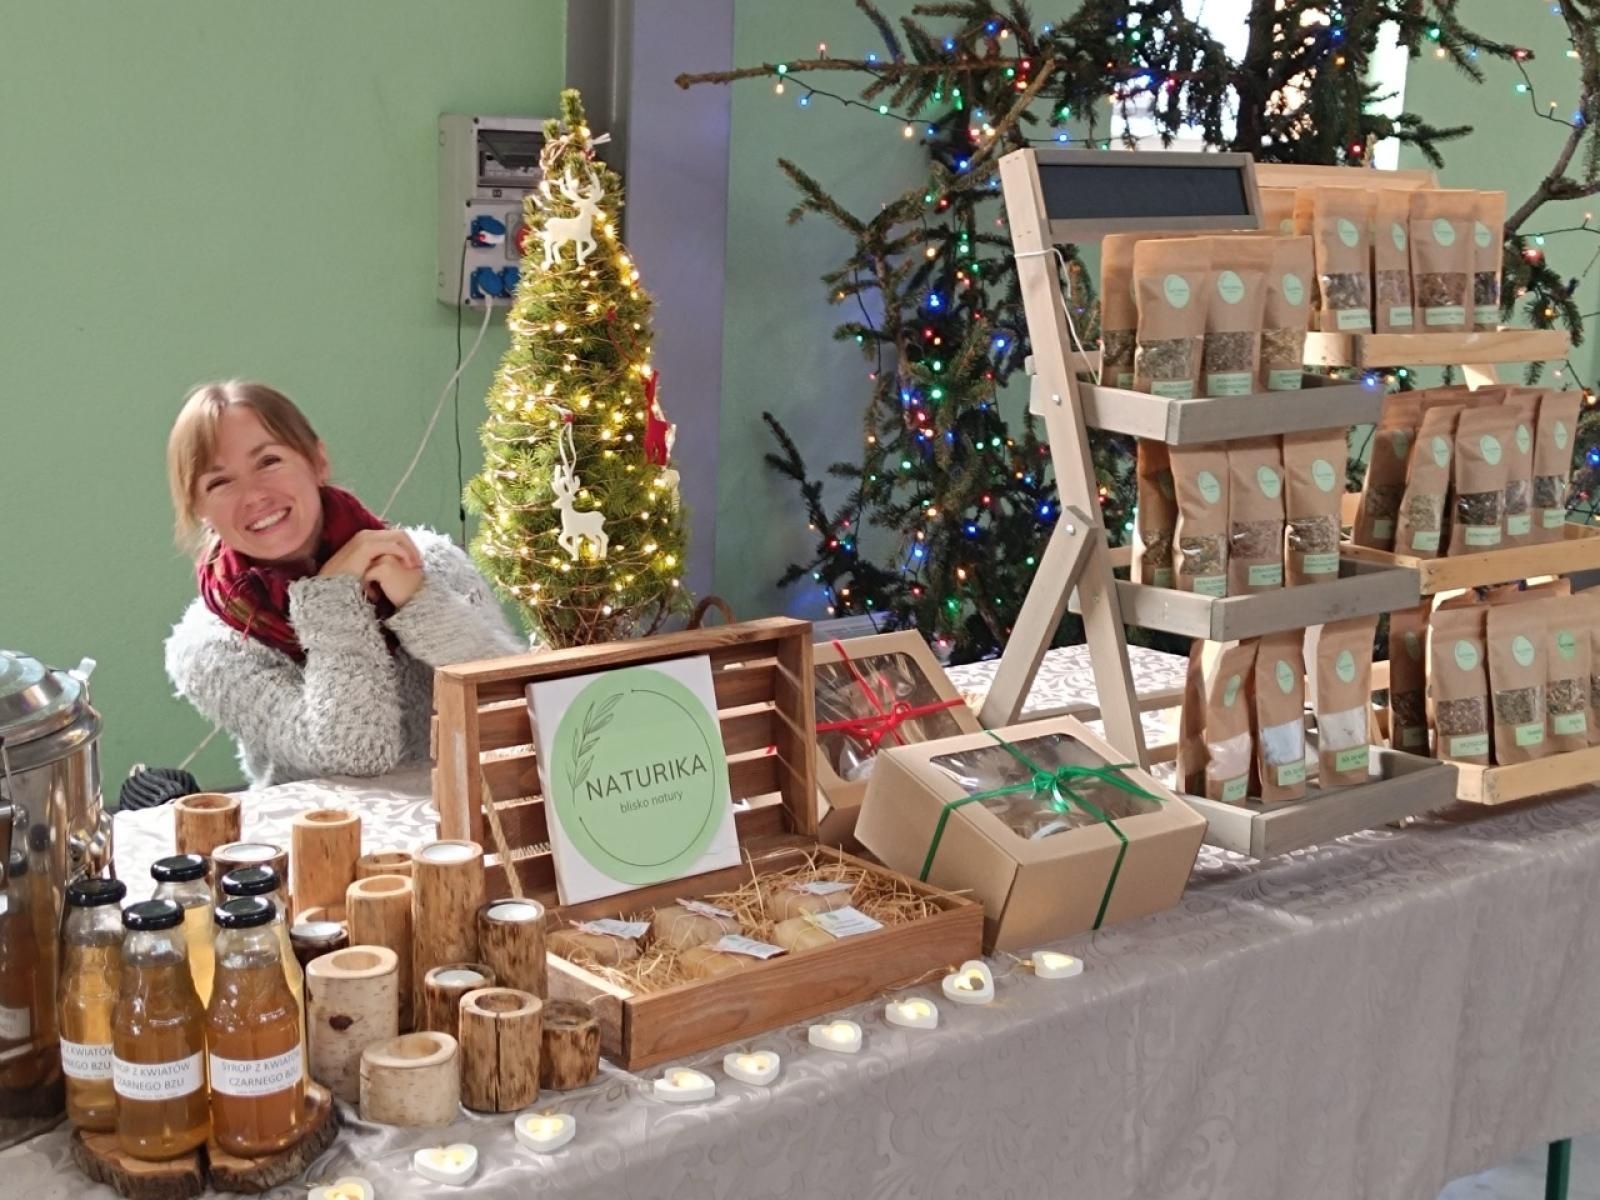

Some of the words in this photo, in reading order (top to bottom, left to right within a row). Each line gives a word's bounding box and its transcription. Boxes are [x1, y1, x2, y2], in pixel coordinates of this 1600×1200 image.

[586, 754, 707, 799] NATURIKA
[620, 796, 649, 814] blisko
[651, 791, 683, 806] natury
[91, 1059, 111, 1070] BZU
[132, 1067, 138, 1076] Z
[140, 1061, 191, 1077] KWIATÓW
[255, 1063, 261, 1073] Z
[164, 1078, 185, 1090] BZU
[229, 1072, 284, 1087] CZARNEGO
